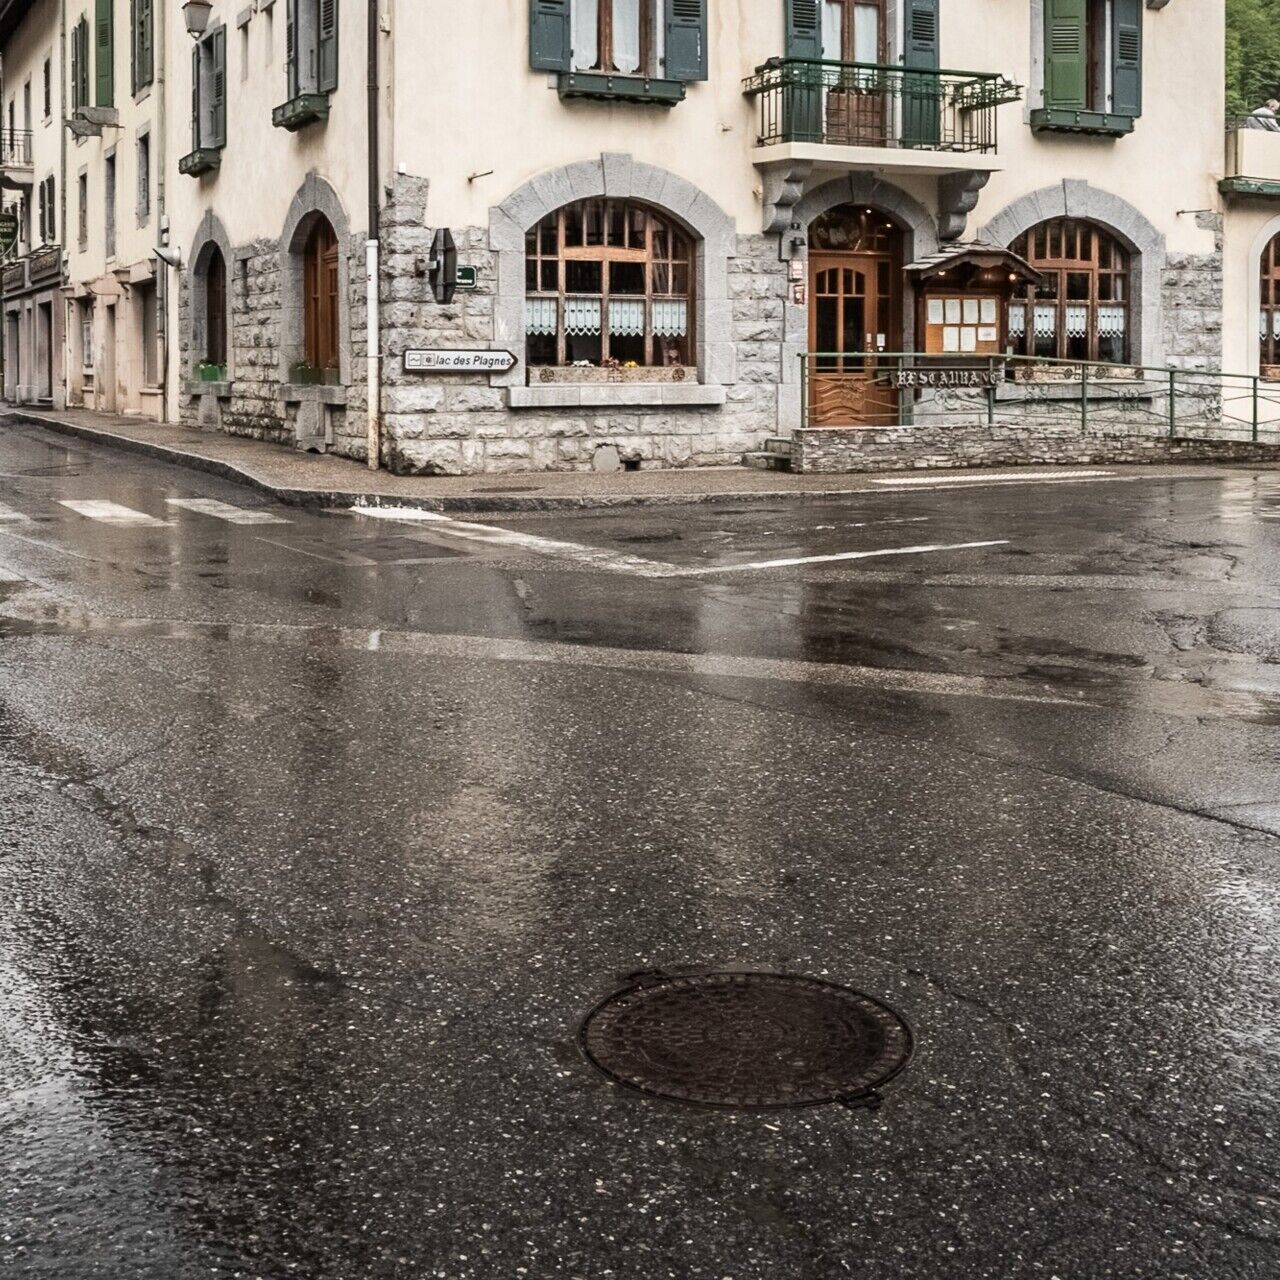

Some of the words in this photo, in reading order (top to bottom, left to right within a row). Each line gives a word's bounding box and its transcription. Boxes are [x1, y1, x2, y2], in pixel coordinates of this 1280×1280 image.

[436, 355, 451, 365] lac
[453, 355, 471, 366] des
[473, 355, 511, 368] Plagnes
